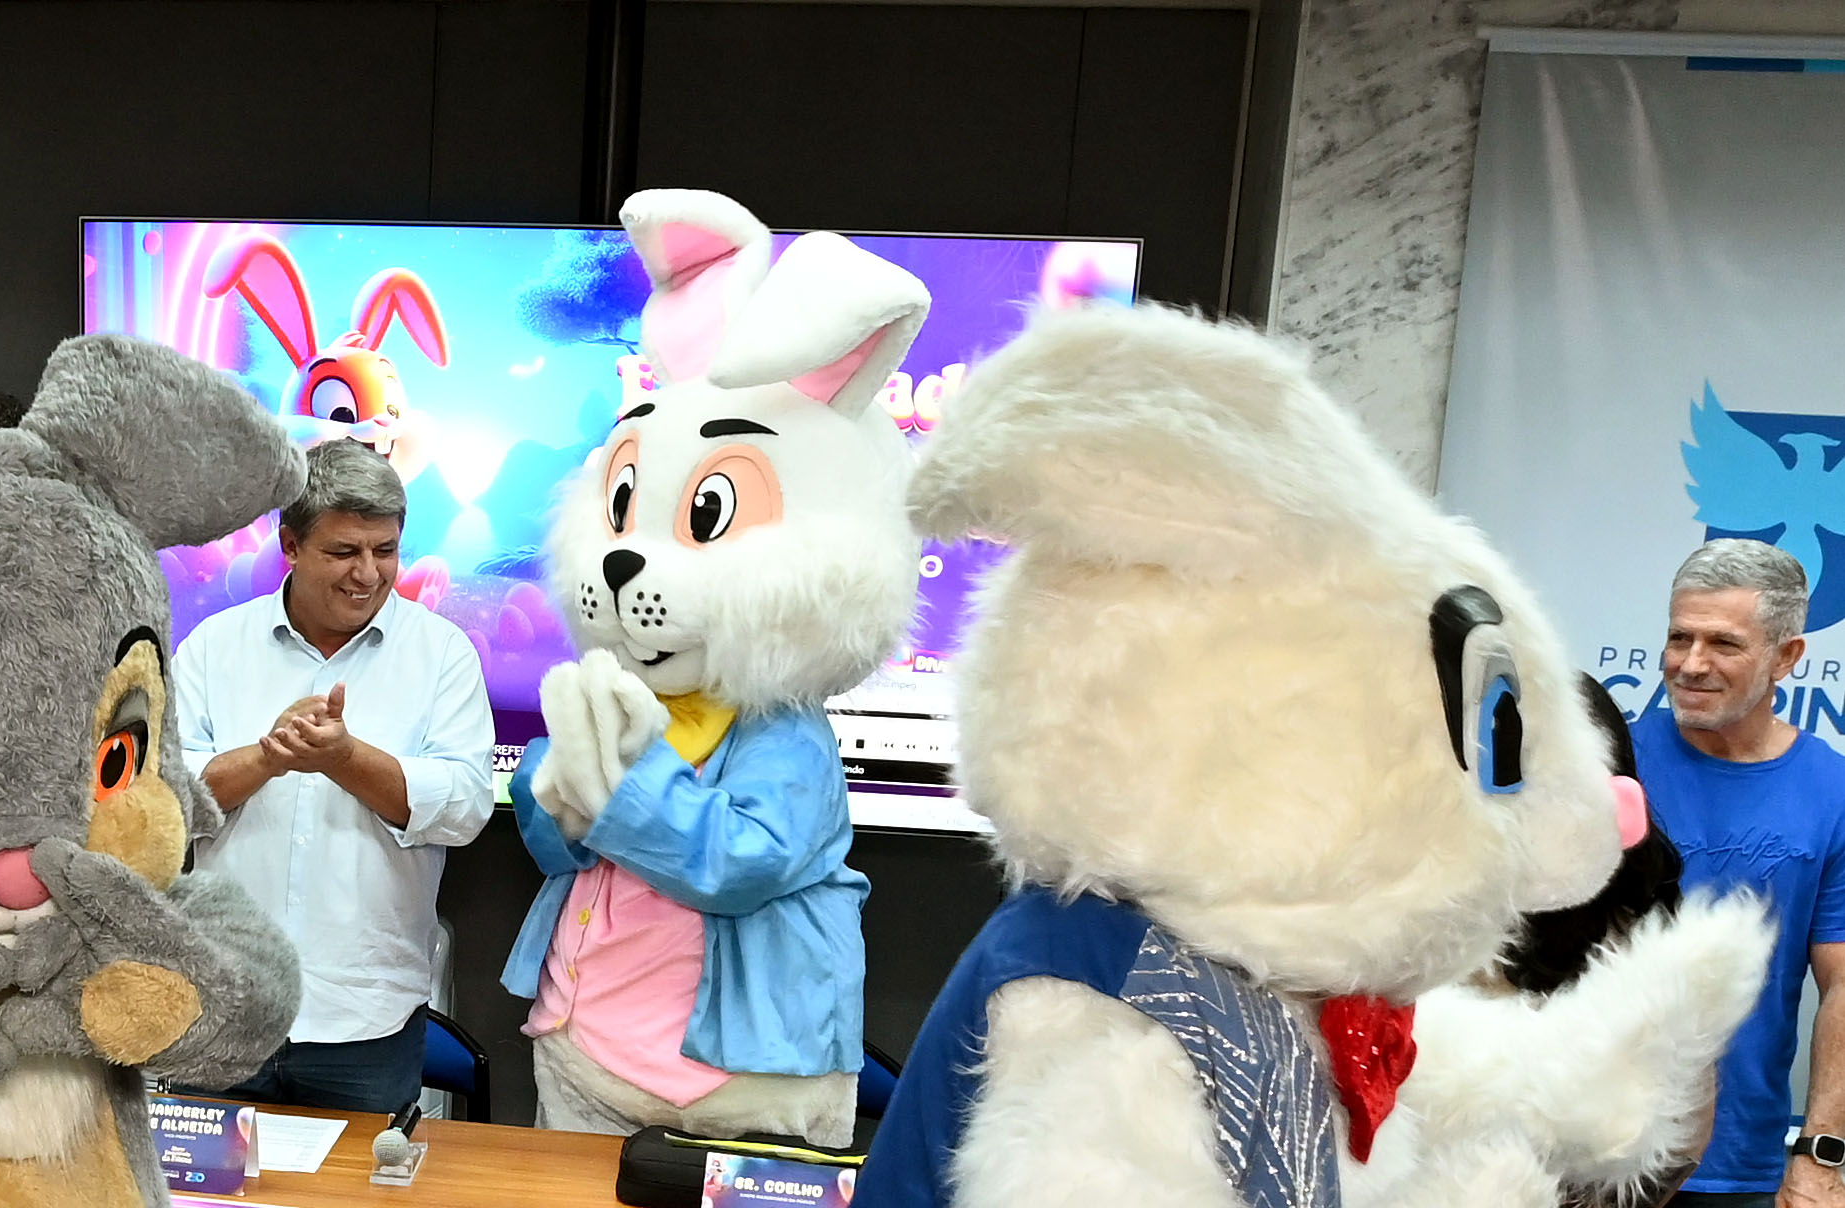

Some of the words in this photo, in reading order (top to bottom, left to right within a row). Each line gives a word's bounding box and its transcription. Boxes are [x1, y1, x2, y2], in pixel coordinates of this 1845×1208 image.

[161, 1119, 223, 1135] ALMEIDA
[734, 1176, 760, 1192] SR.
[763, 1179, 824, 1198] COELHO
